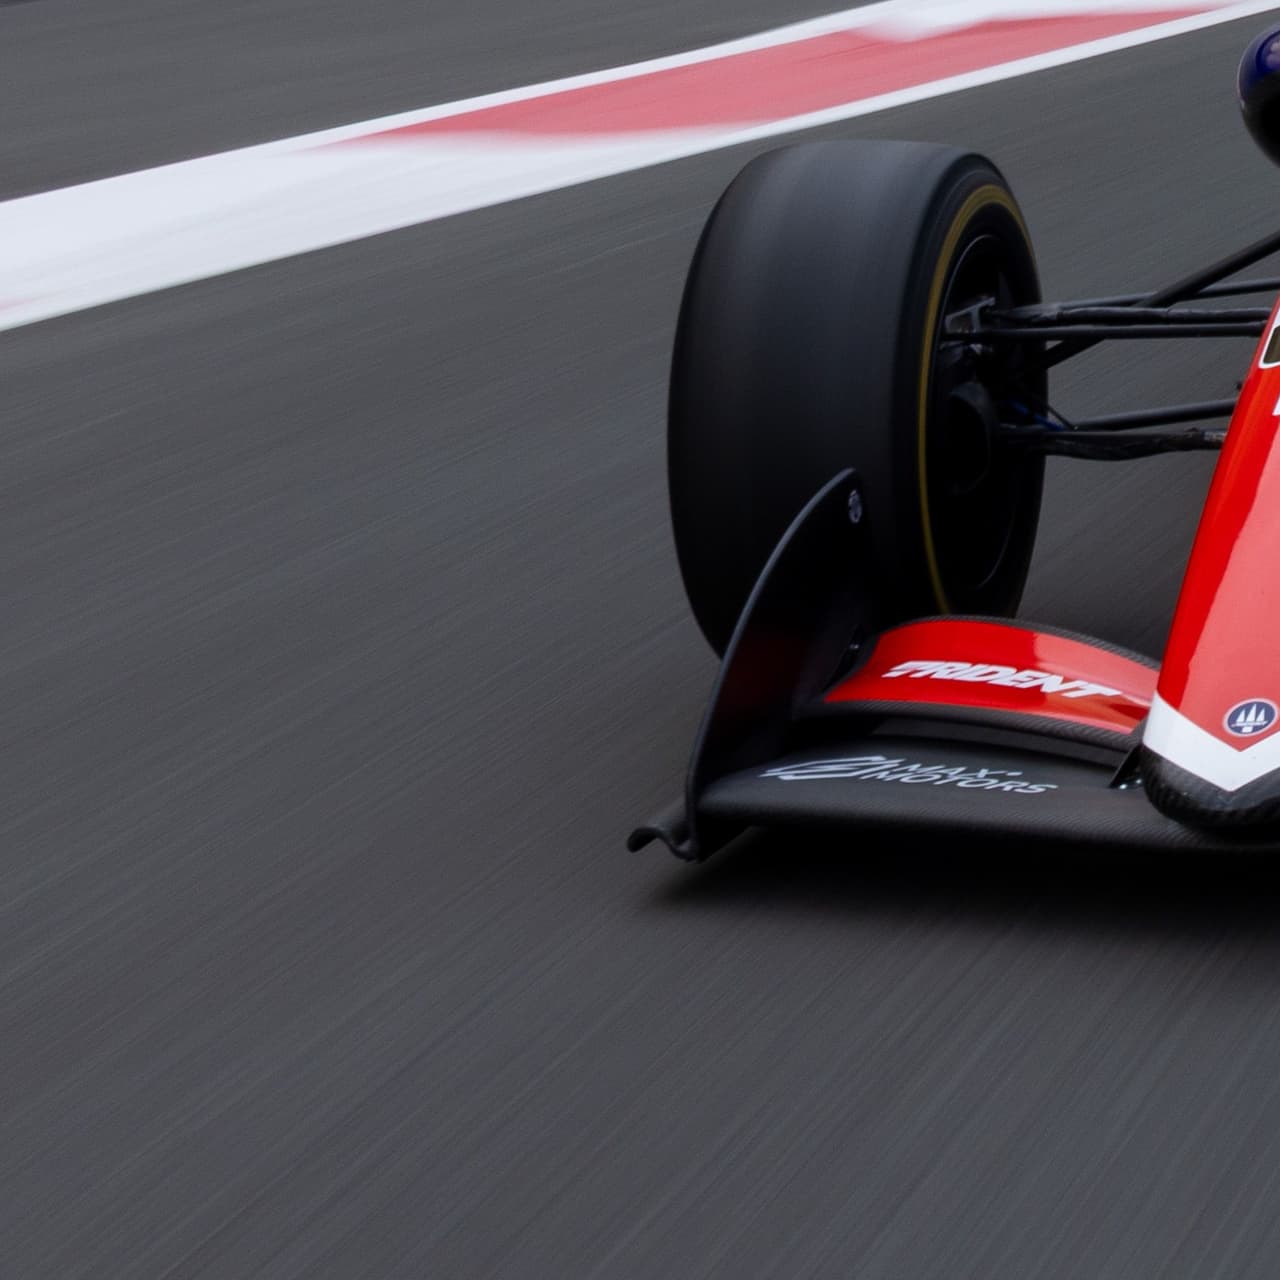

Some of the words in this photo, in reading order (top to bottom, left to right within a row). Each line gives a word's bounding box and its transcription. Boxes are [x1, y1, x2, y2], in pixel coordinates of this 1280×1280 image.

[881, 660, 1123, 698] TRIDENT
[860, 770, 1058, 794] MOTORS
[895, 763, 1008, 778] MAX
